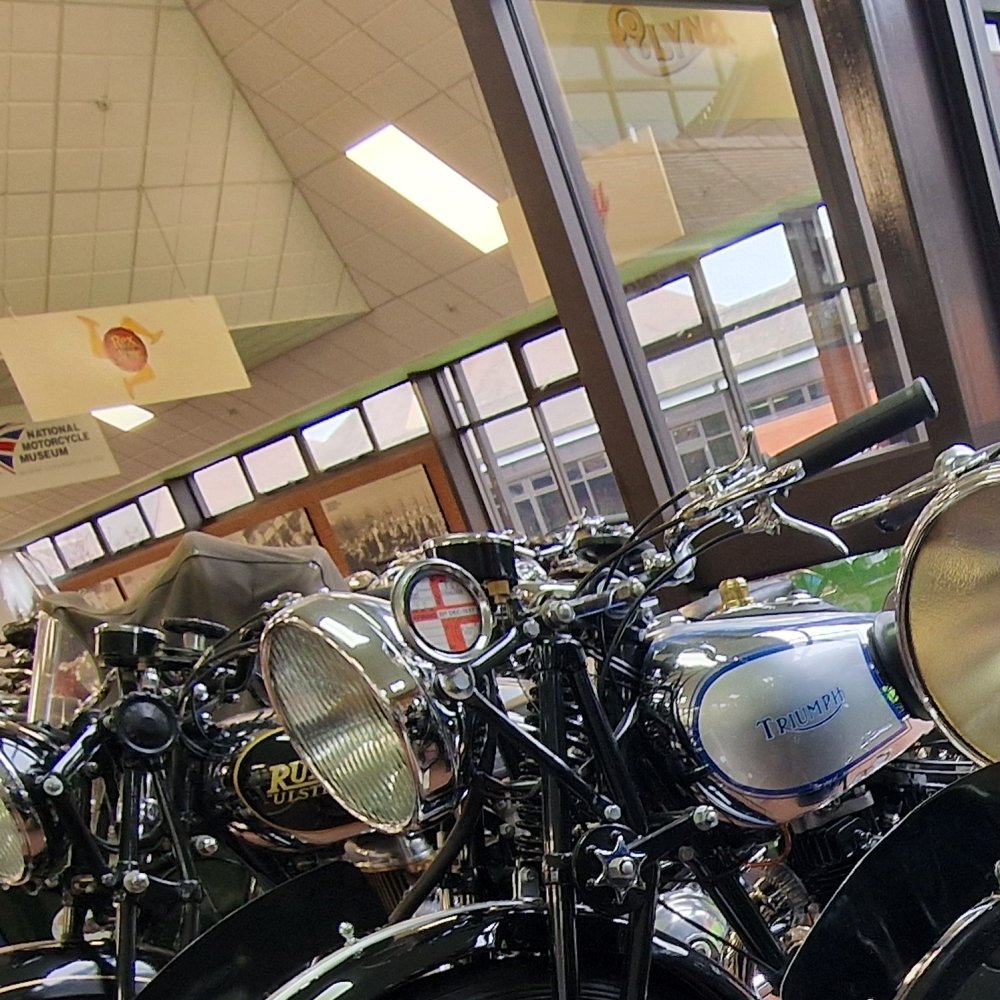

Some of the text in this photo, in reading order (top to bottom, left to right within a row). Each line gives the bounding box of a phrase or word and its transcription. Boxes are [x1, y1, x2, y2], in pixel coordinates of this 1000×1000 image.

[26, 423, 80, 440] NATIONAL
[21, 432, 89, 451] MOTORCYCLE
[19, 446, 69, 463] MUSEUM
[756, 687, 844, 739] TRIUMPH
